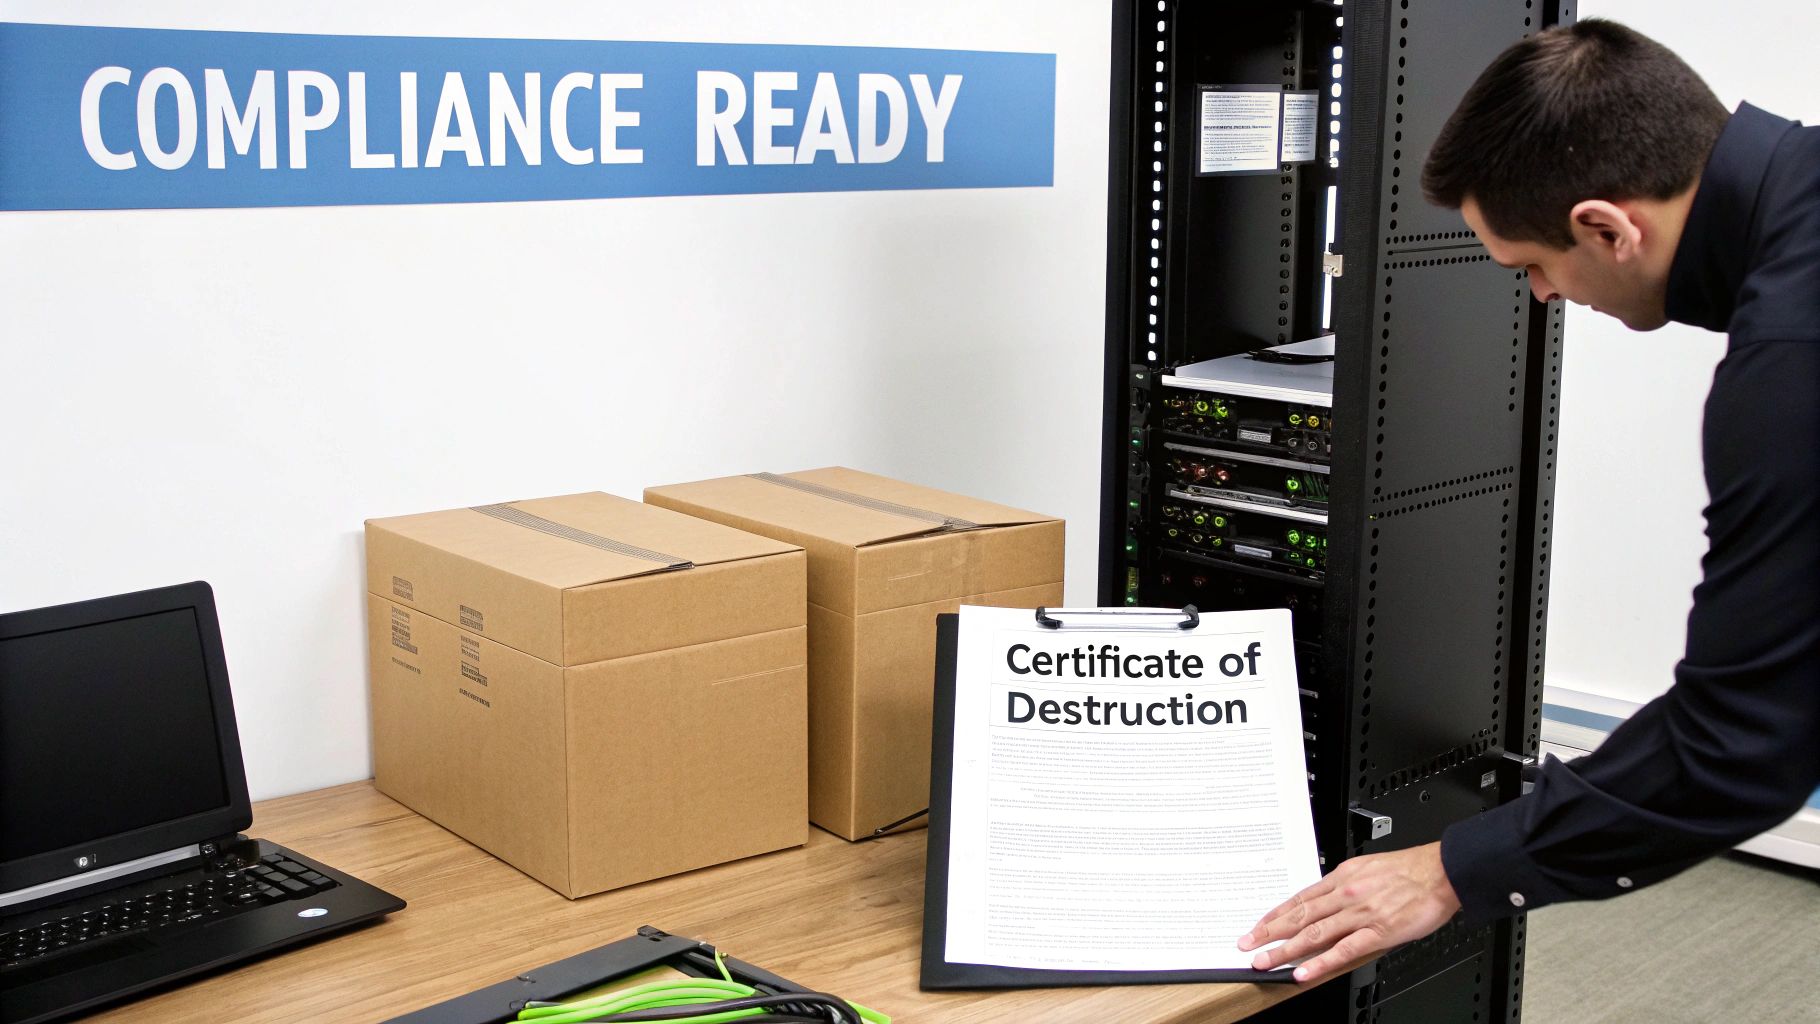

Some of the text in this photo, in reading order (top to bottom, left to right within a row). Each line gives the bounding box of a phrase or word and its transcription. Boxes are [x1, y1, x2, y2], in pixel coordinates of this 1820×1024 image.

[80, 66, 964, 171] COMPLIANCE READY
[1006, 641, 1262, 679] Certificate of
[1007, 691, 1248, 727] Destruction
